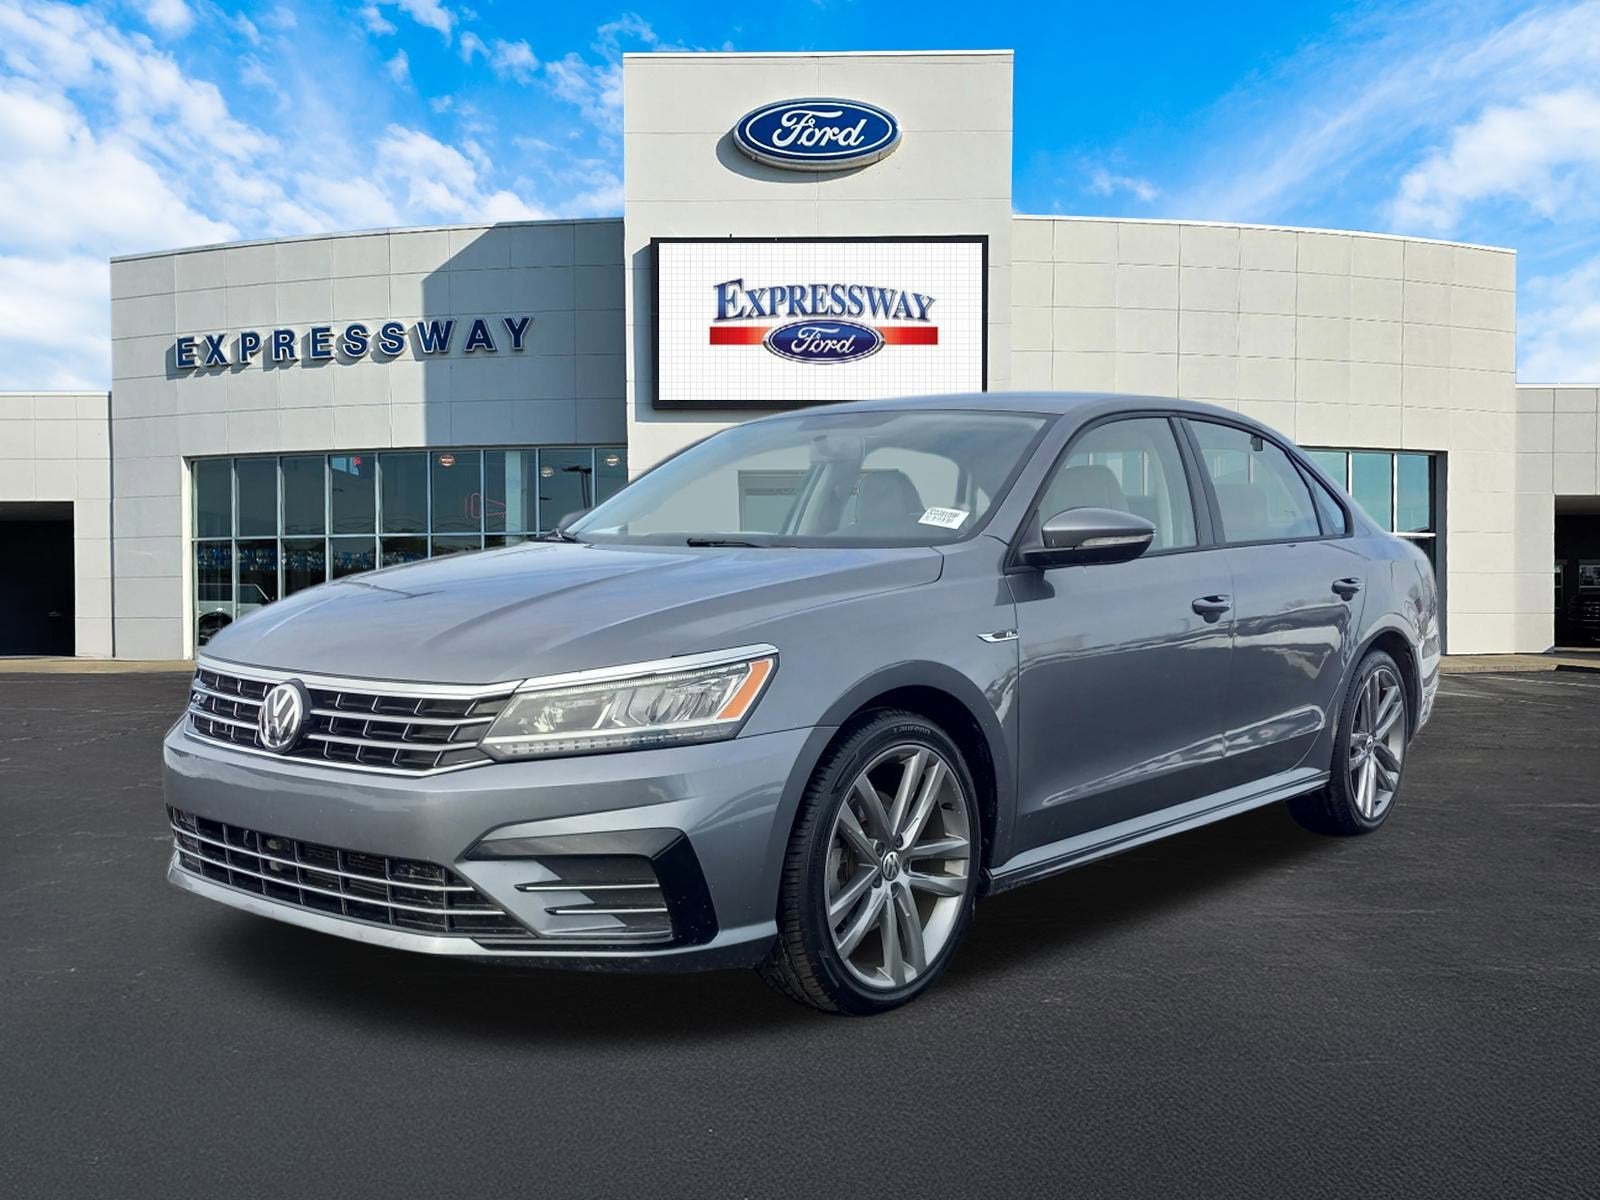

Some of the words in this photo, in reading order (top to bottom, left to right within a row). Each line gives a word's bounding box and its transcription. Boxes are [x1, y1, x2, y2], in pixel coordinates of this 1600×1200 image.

[772, 109, 868, 147] Ford
[175, 316, 533, 369] EXPRESSWAY
[790, 326, 854, 354] Ford
